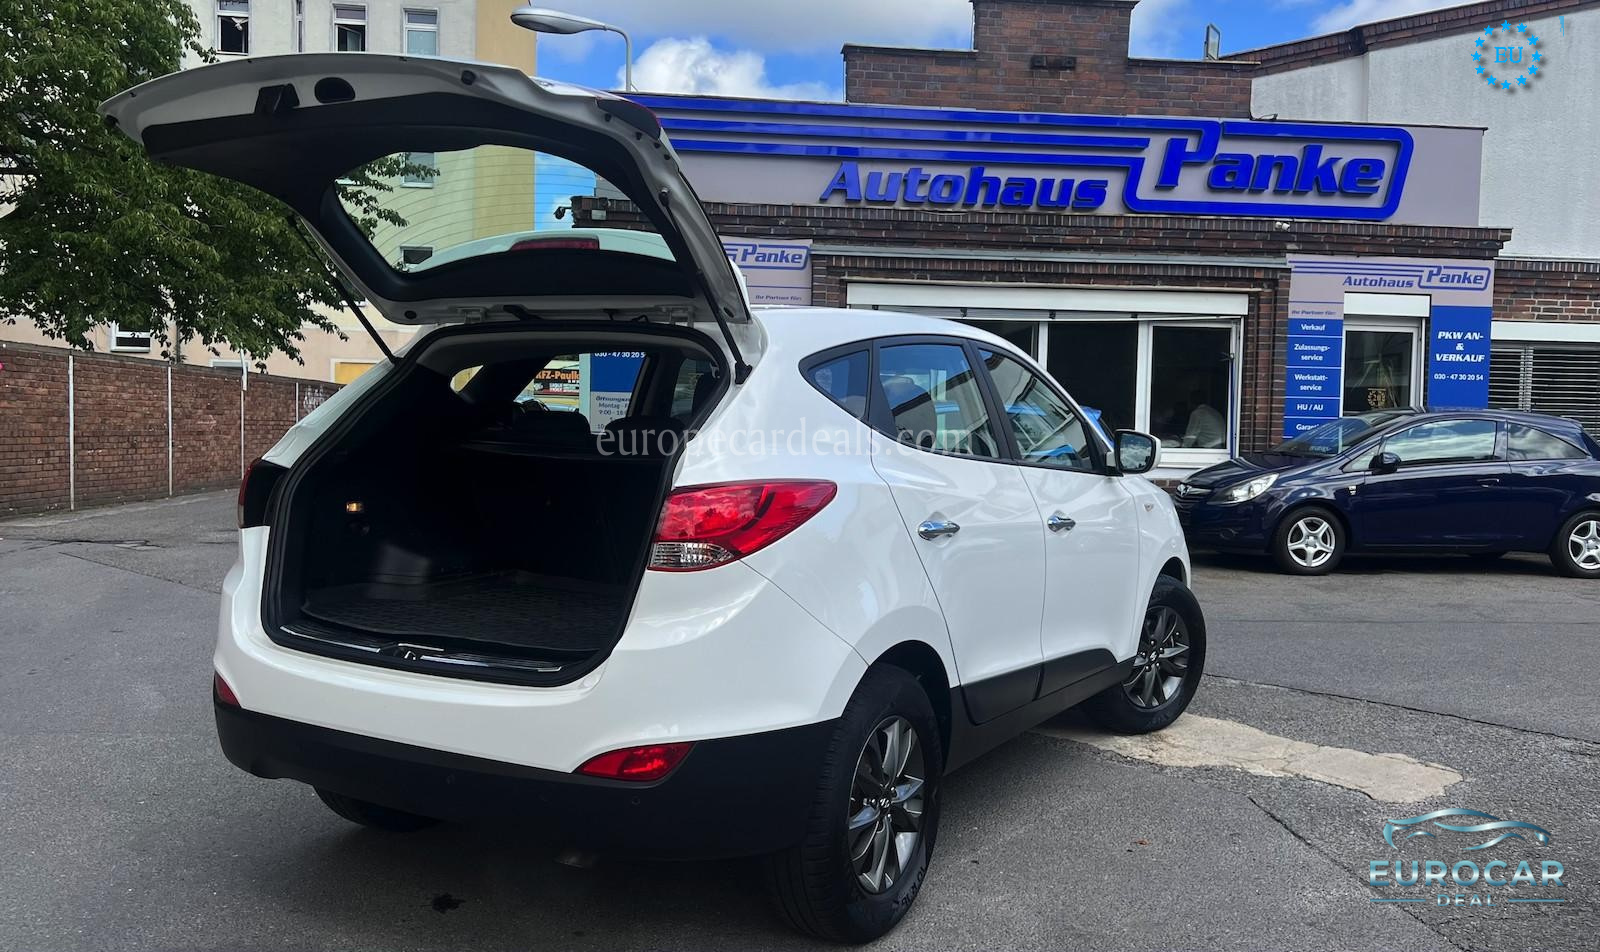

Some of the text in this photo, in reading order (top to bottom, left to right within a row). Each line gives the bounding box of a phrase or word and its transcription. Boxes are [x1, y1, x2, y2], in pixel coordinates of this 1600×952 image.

[819, 121, 1387, 210] Autohaus Panke
[741, 244, 803, 264] Panke
[1342, 266, 1485, 289] Autohaus Panke
[1301, 323, 1326, 331] Verkauf
[1437, 331, 1484, 340] PKW AN-
[1293, 343, 1331, 353] Zulassungs-
[1455, 342, 1464, 351] &
[1435, 353, 1486, 362] VERKAUF
[1459, 373, 1467, 381] 30
